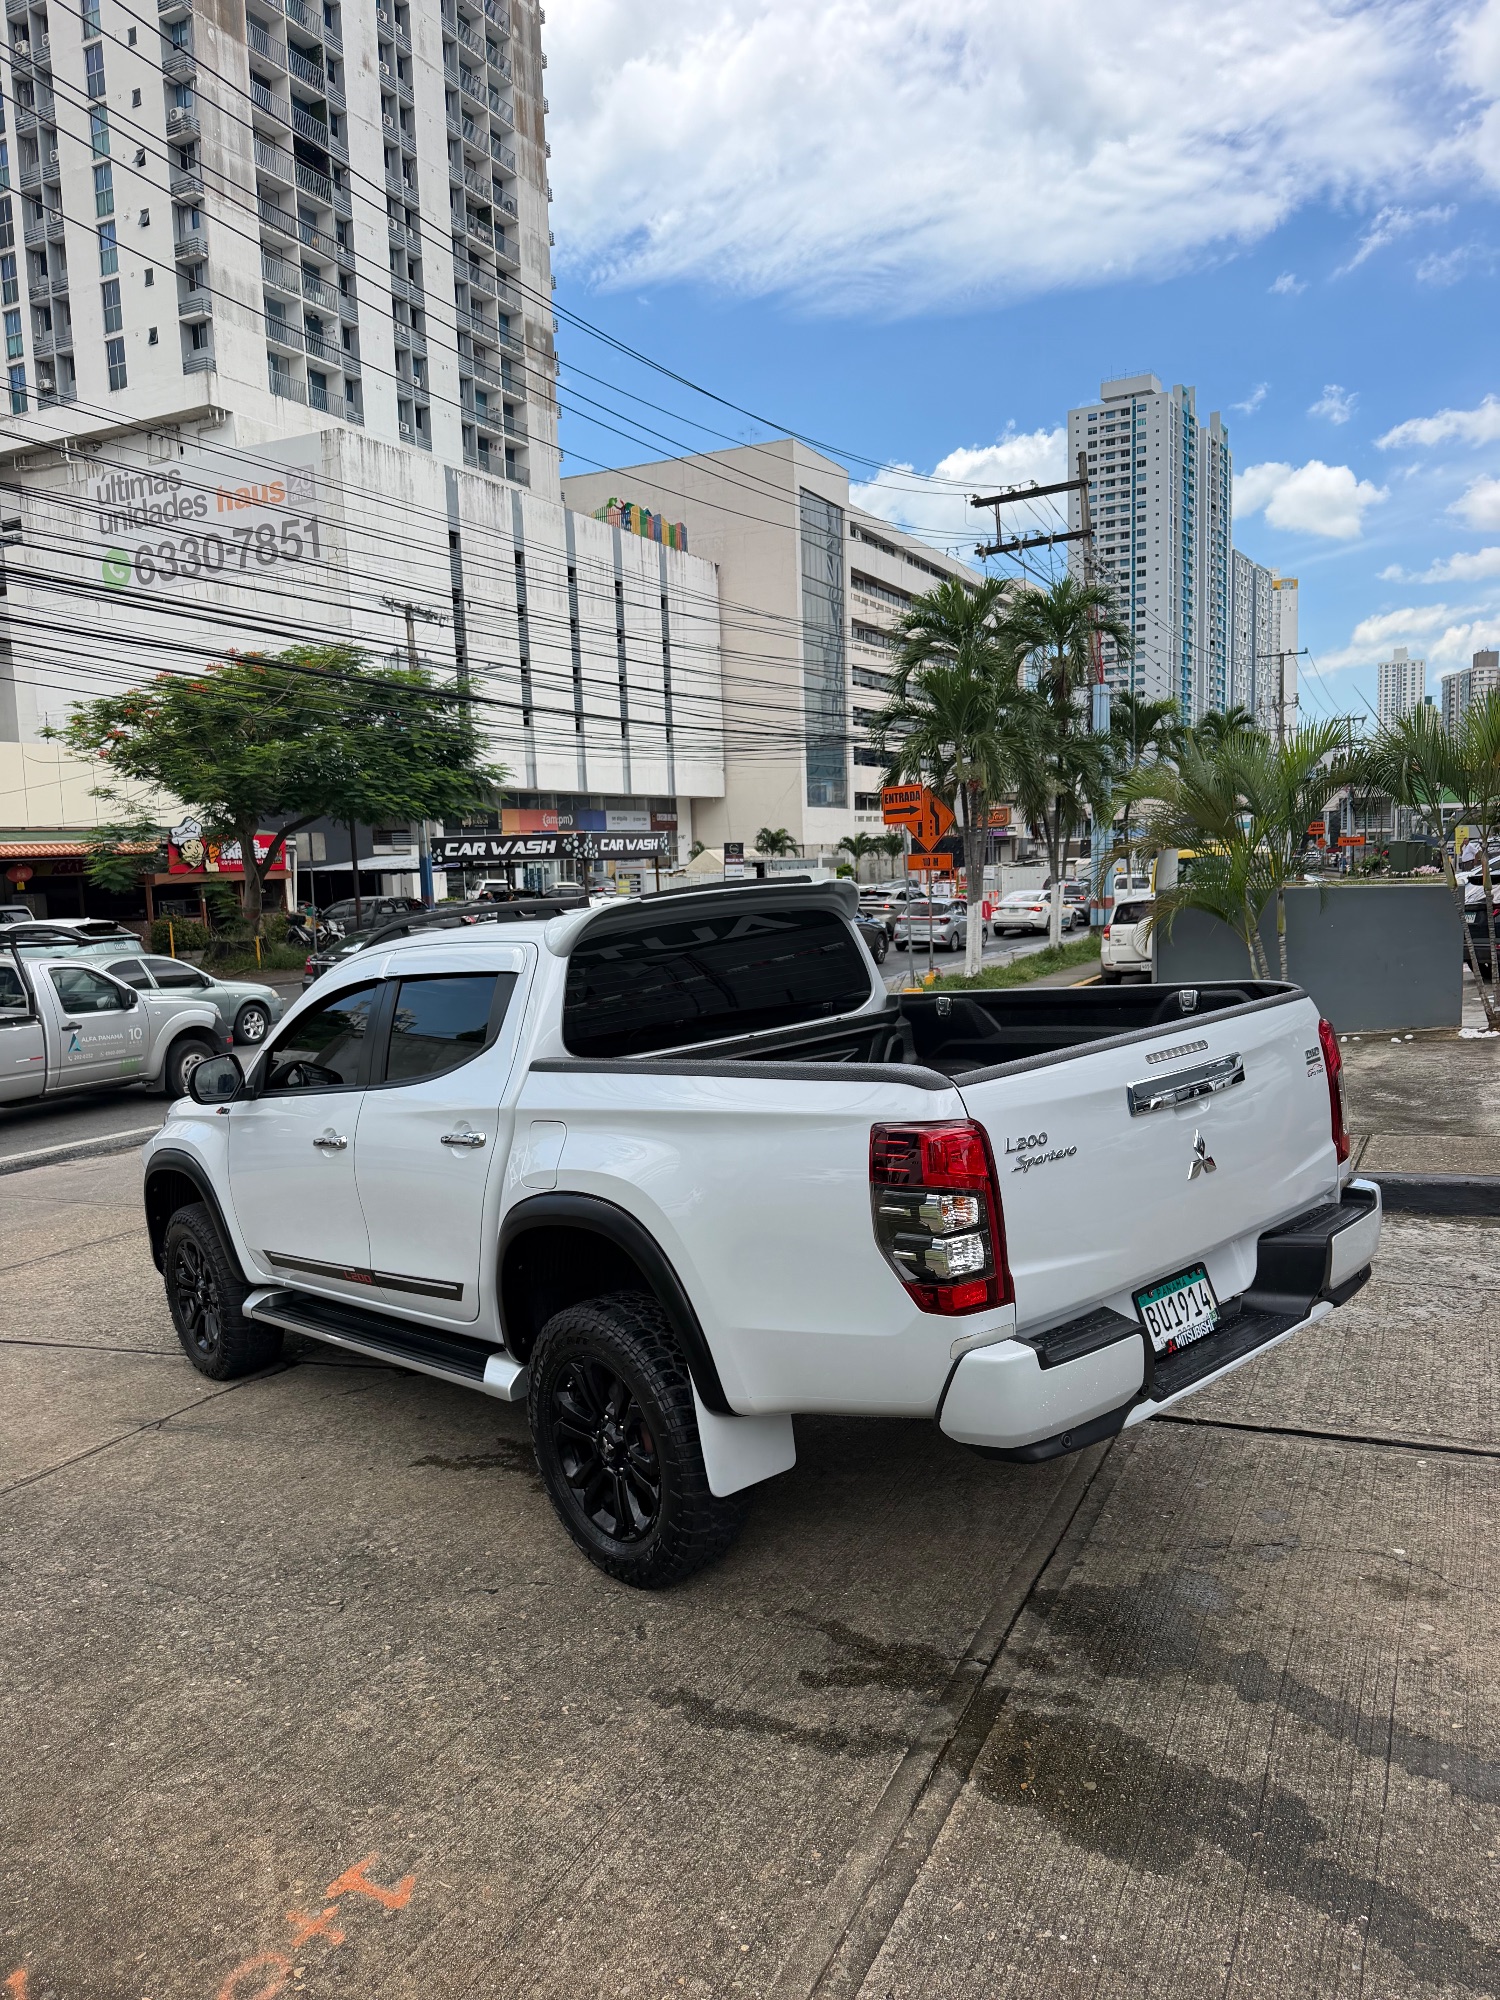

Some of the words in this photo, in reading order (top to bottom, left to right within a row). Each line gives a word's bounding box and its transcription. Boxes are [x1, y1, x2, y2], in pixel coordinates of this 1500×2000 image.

[97, 468, 182, 506] últimas
[290, 470, 312, 491] 20
[216, 481, 286, 512] haus
[99, 492, 208, 535] unidades
[135, 515, 321, 585] 6330-7851
[884, 791, 920, 804] ENTRADA
[444, 842, 487, 857] CAR
[491, 839, 556, 856] WASH
[600, 839, 624, 851] CAR
[625, 838, 658, 851] WASH
[81, 1035, 97, 1043] ALFA
[128, 1027, 143, 1041] 10
[1004, 1132, 1048, 1154] L200
[1010, 1145, 1078, 1173] Sportero
[343, 1270, 372, 1284] L200
[1156, 1279, 1187, 1298] PANAMA
[1145, 1282, 1212, 1338] BU1914
[1175, 1319, 1215, 1349] MITSUBISHI
